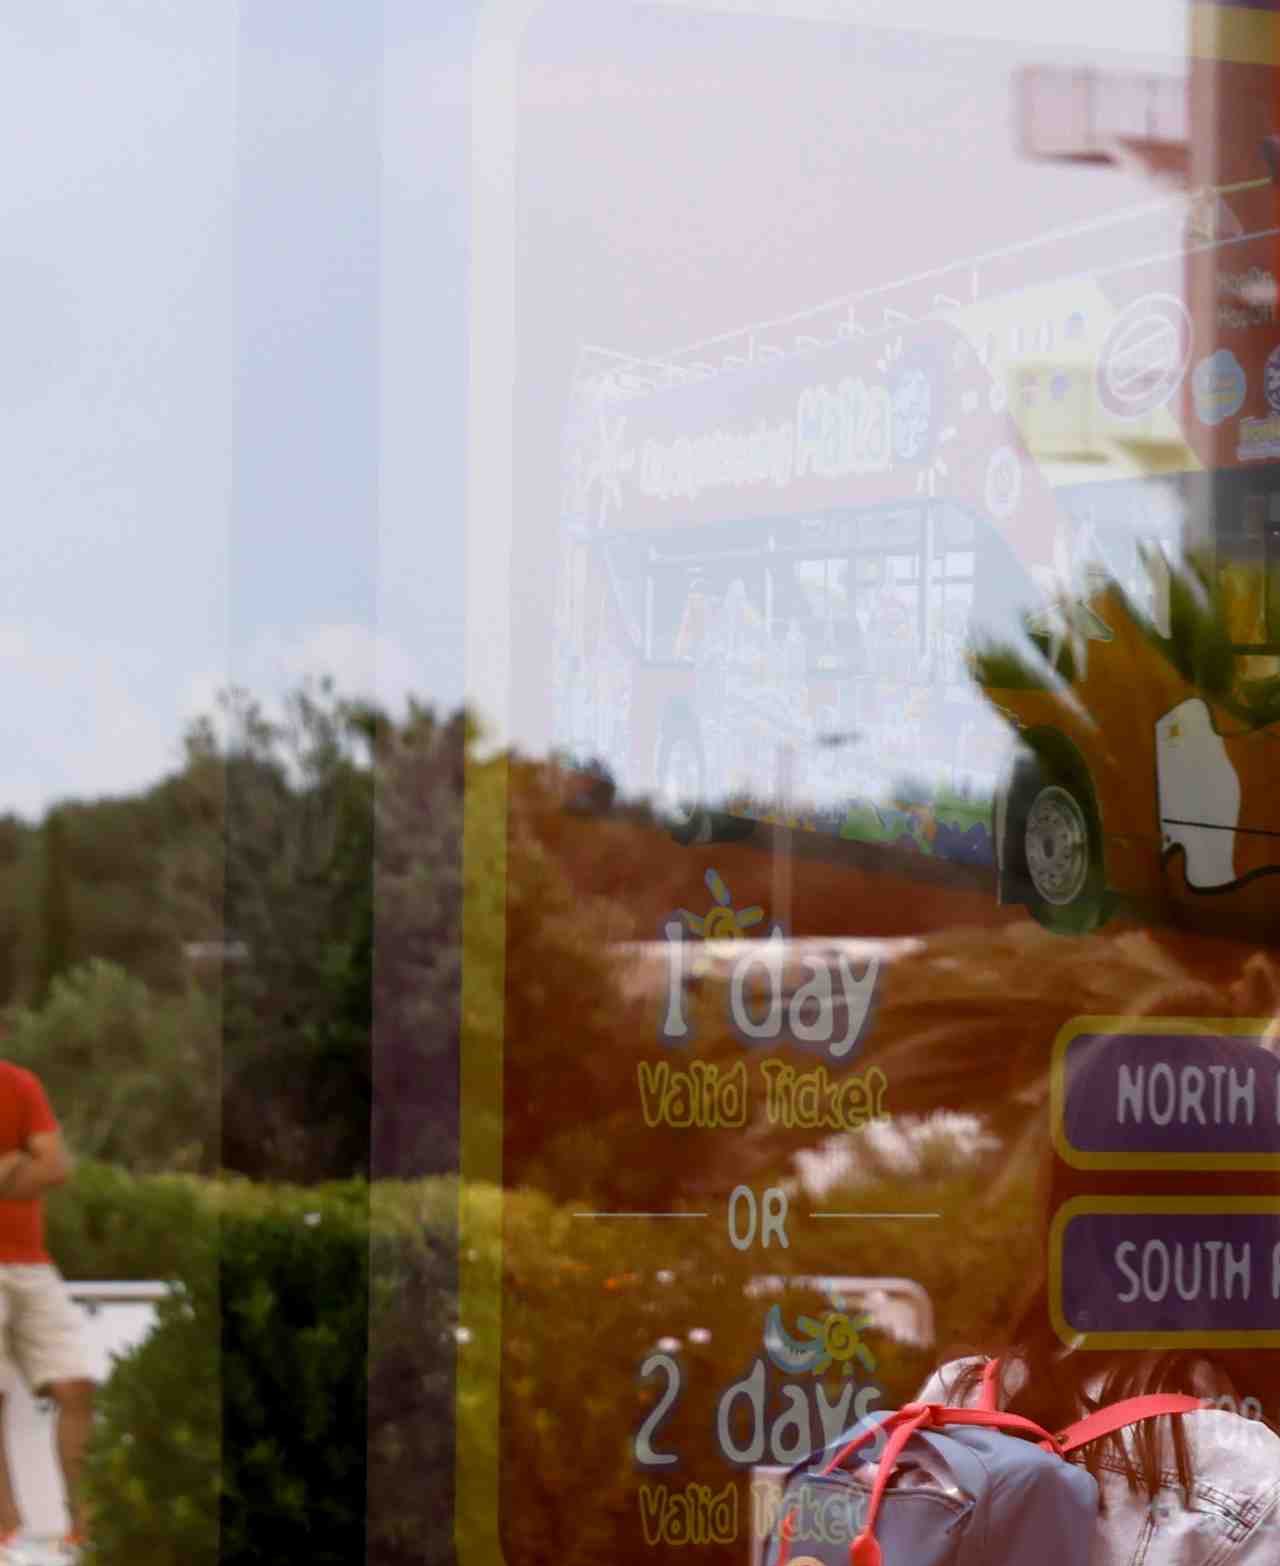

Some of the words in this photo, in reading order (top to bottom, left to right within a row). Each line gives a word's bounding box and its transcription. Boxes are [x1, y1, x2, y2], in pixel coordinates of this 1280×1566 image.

[662, 921, 690, 1037] 1
[731, 924, 884, 1057] day
[638, 1060, 747, 1128] Valid
[764, 1058, 890, 1131] Ticket
[1116, 1063, 1256, 1127] NORTH
[726, 1186, 790, 1252] OR
[1114, 1239, 1251, 1304] SOUTH
[636, 1355, 681, 1465] 2
[717, 1356, 888, 1476] days
[638, 1483, 738, 1545] Valid
